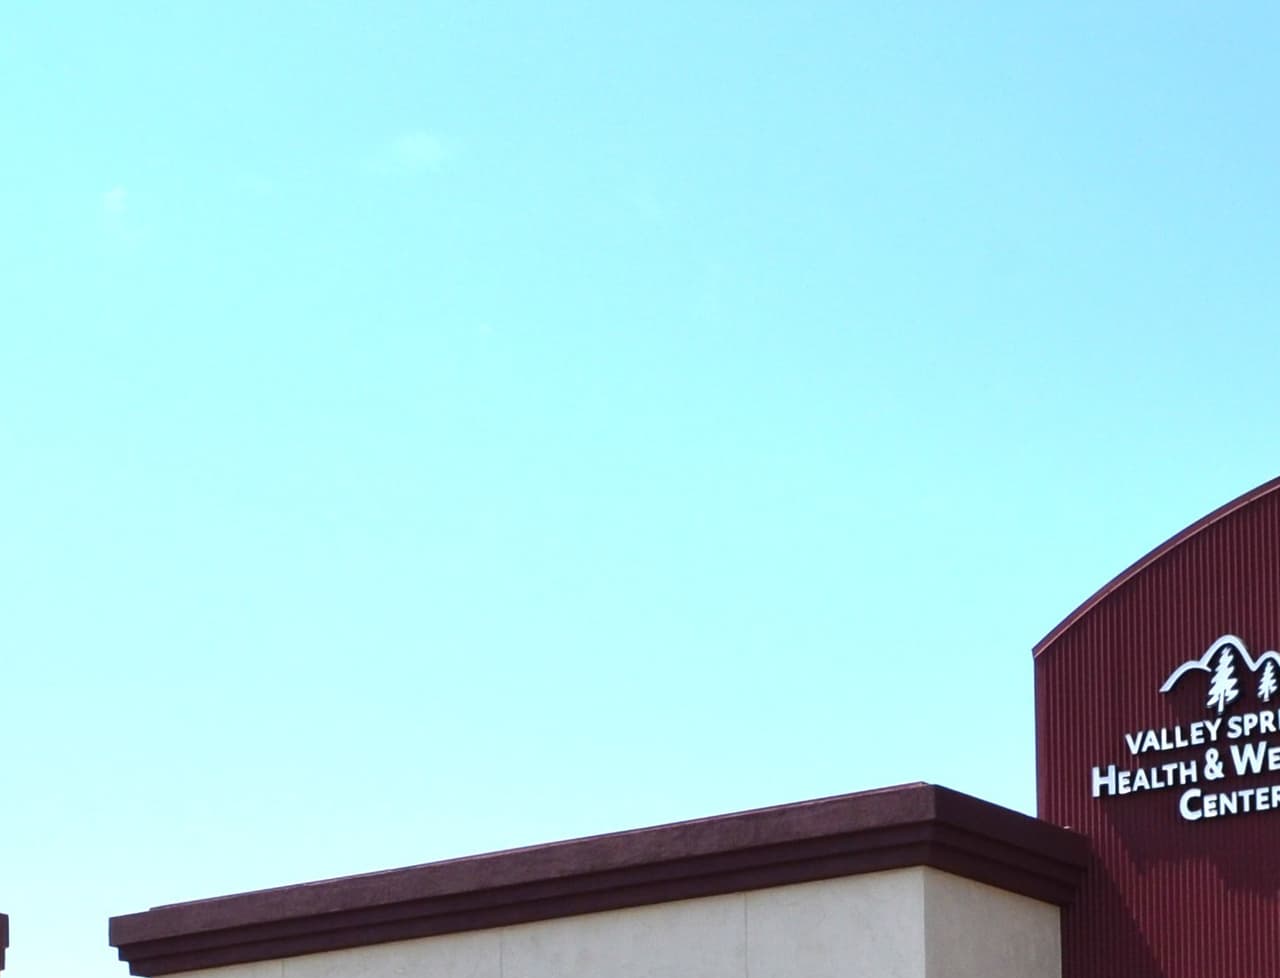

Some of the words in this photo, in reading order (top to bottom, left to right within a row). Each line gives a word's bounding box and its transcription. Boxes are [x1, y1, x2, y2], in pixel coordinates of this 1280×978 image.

[1125, 717, 1222, 755] VALLEY
[1091, 760, 1198, 798] HEALTH
[1203, 748, 1225, 781] &
